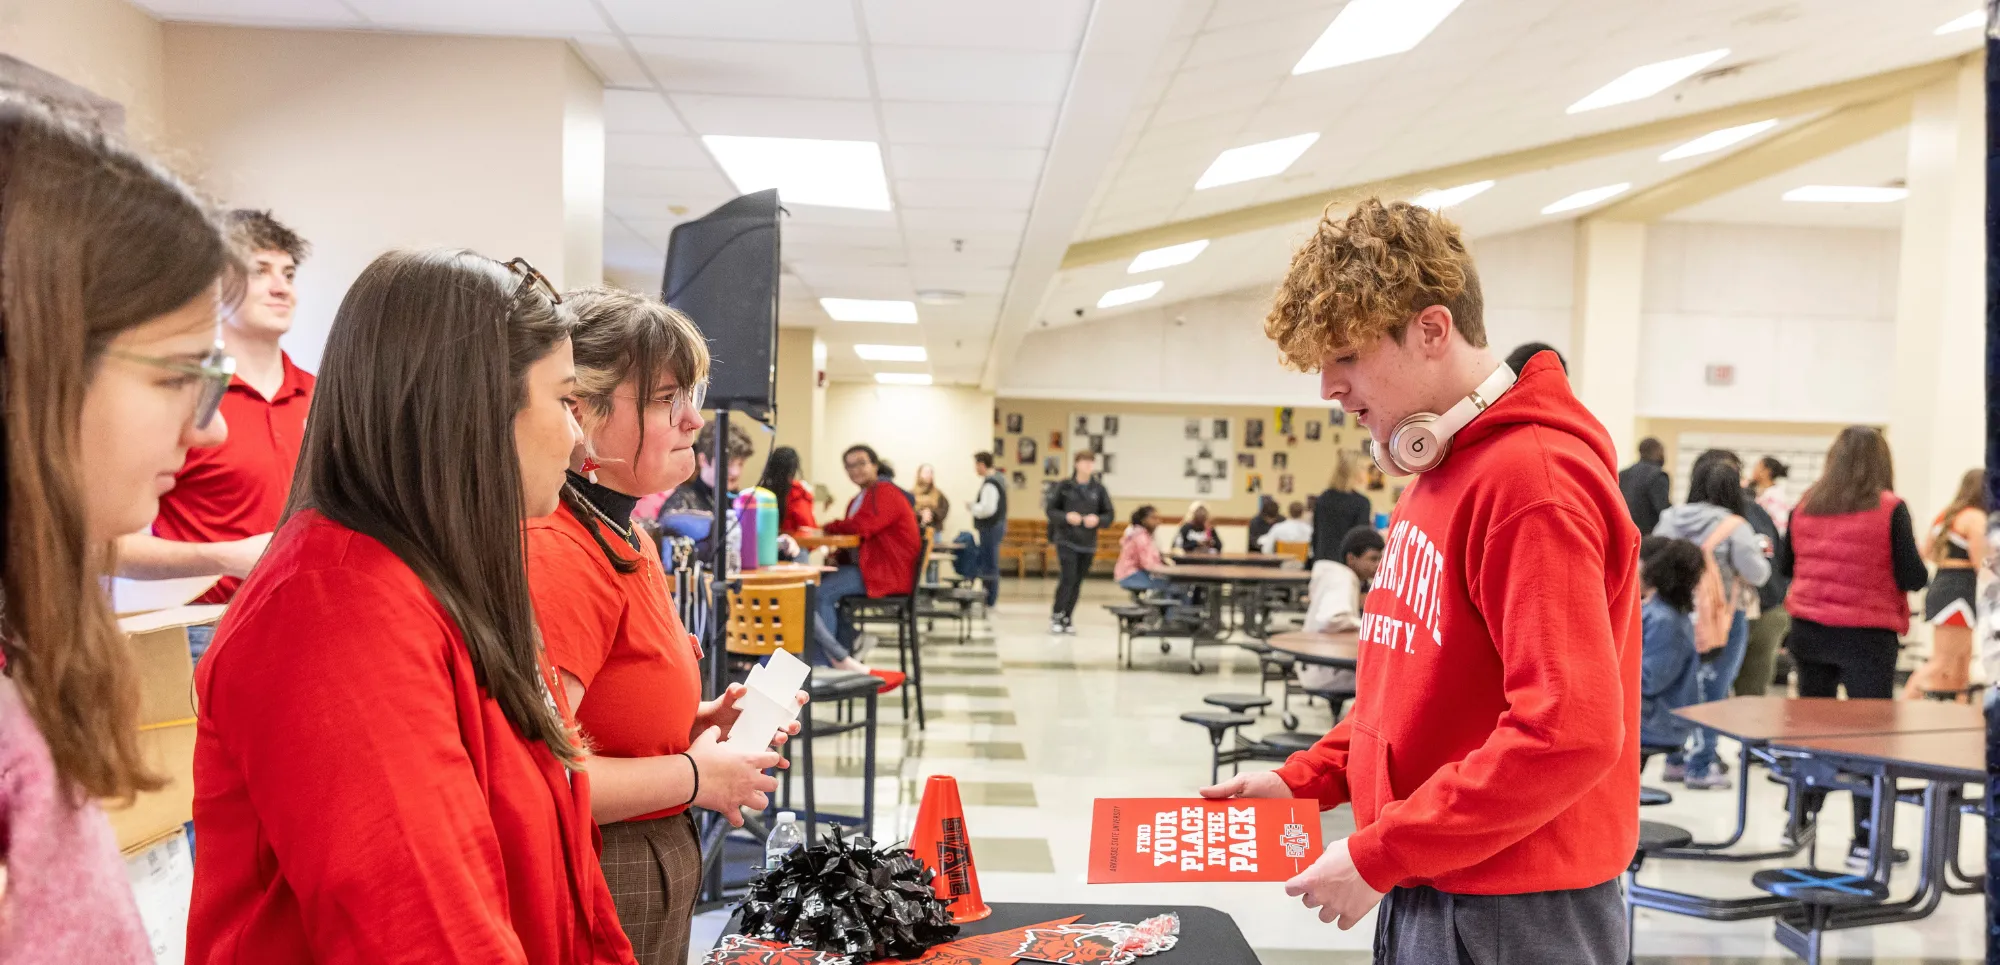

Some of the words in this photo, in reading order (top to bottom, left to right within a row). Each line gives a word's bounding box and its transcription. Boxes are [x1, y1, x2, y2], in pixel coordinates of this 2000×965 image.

[1111, 832, 1120, 846] STATE
[1136, 824, 1151, 853] FIND
[1154, 811, 1178, 867] YOUR
[1181, 806, 1204, 871] PLACE
[1207, 812, 1226, 844] THE
[1227, 806, 1258, 872] PACK
[1208, 848, 1226, 866] IN
